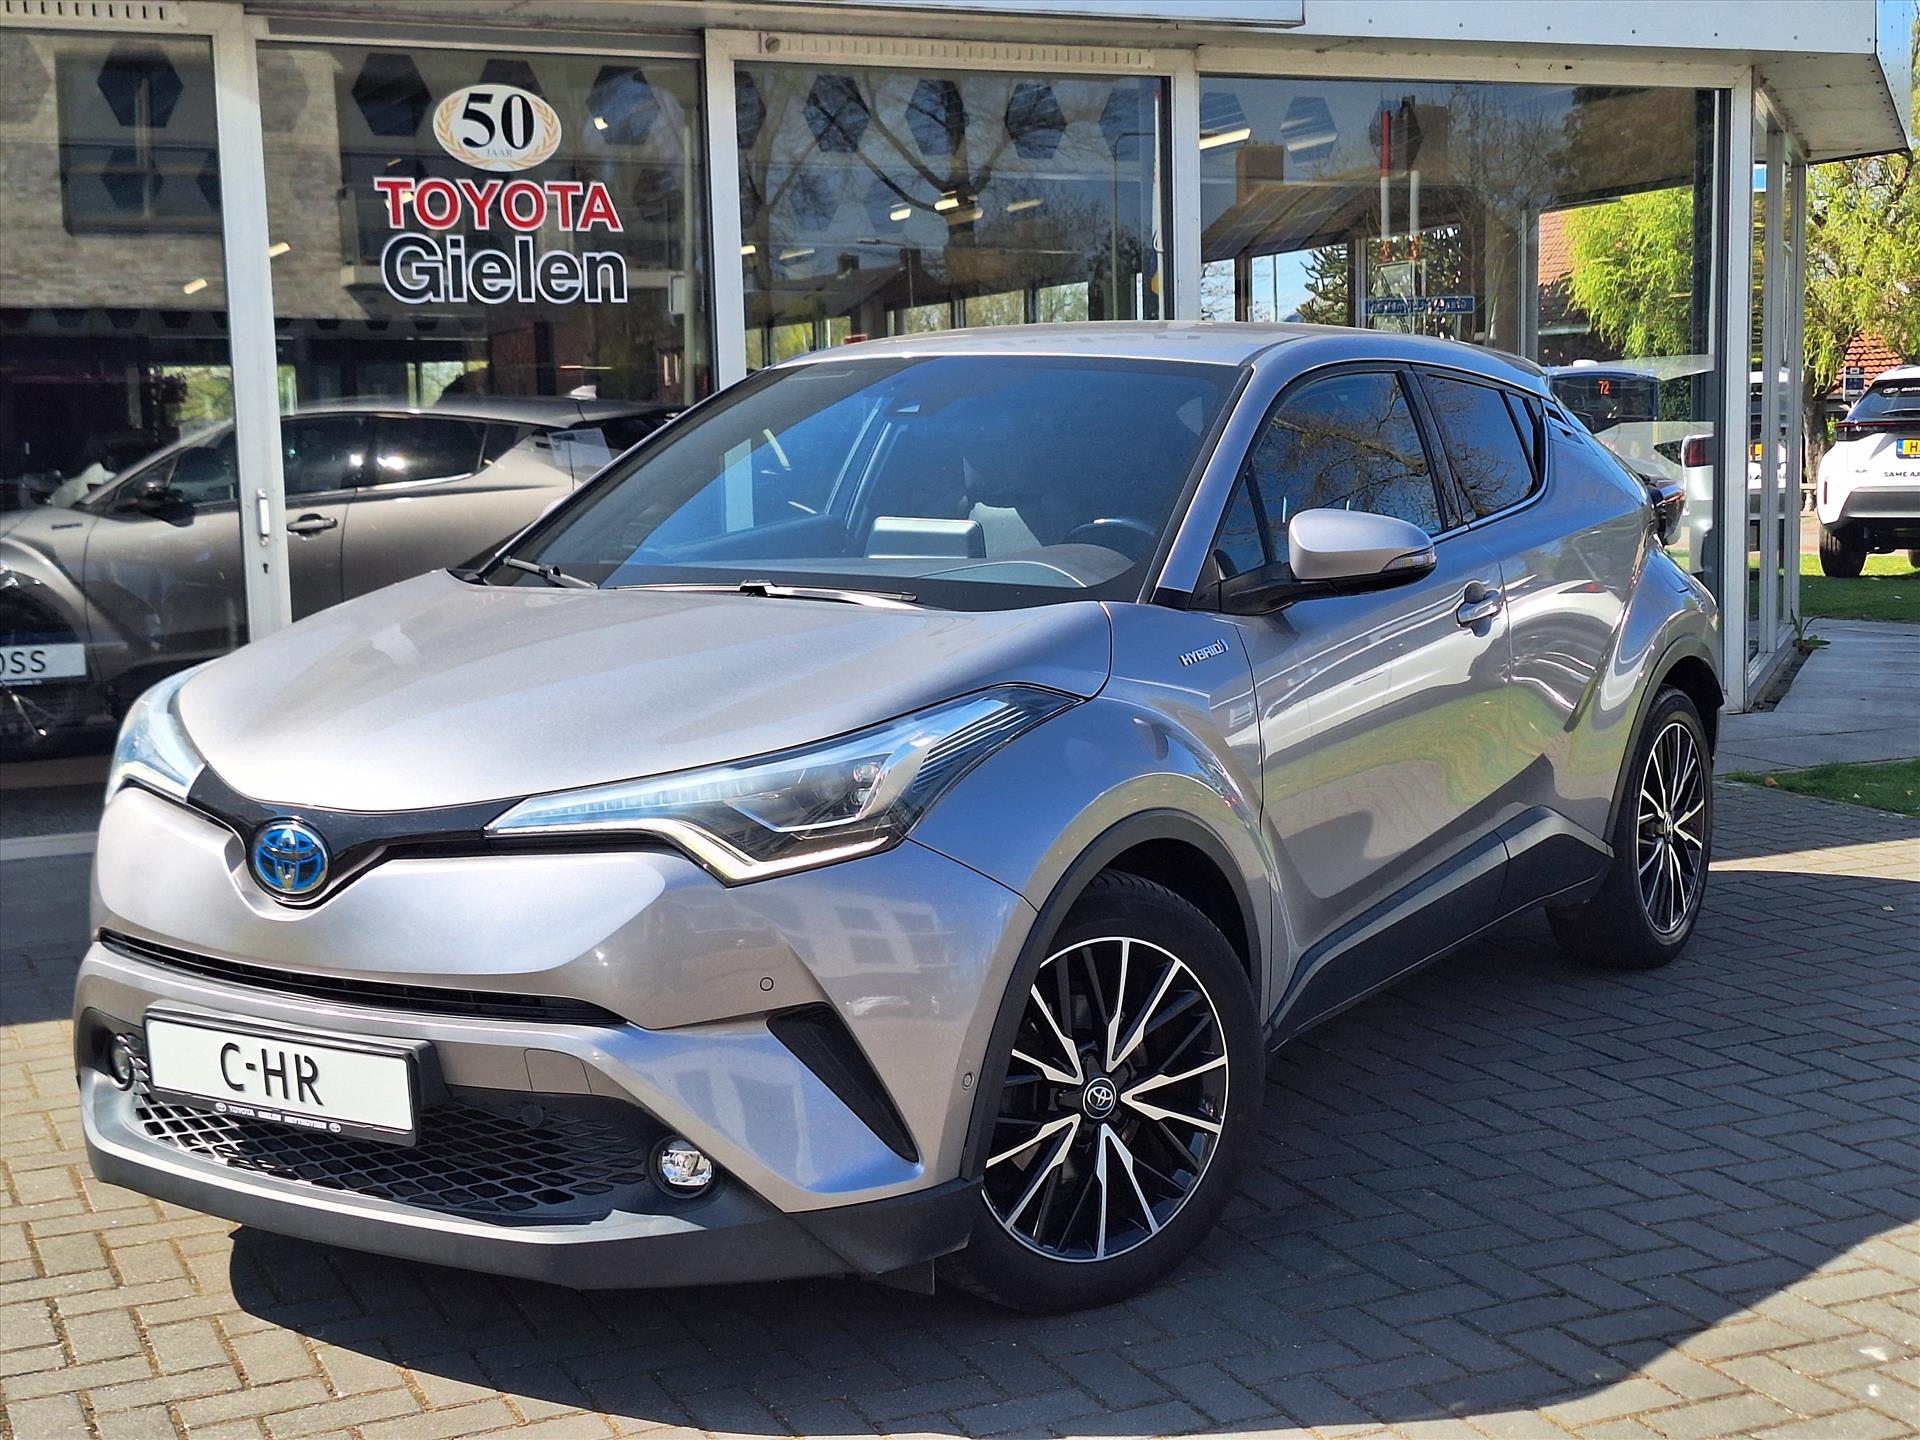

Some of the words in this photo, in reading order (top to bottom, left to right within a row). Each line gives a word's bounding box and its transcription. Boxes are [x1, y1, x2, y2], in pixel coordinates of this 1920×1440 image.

[462, 93, 535, 150] 50
[487, 149, 512, 158] JAAR
[374, 177, 623, 232] TOYOTA
[381, 232, 628, 304] Gielen
[1598, 380, 1610, 395] 72
[1180, 641, 1225, 666] HYBRID
[220, 1042, 323, 1106] C-HR
